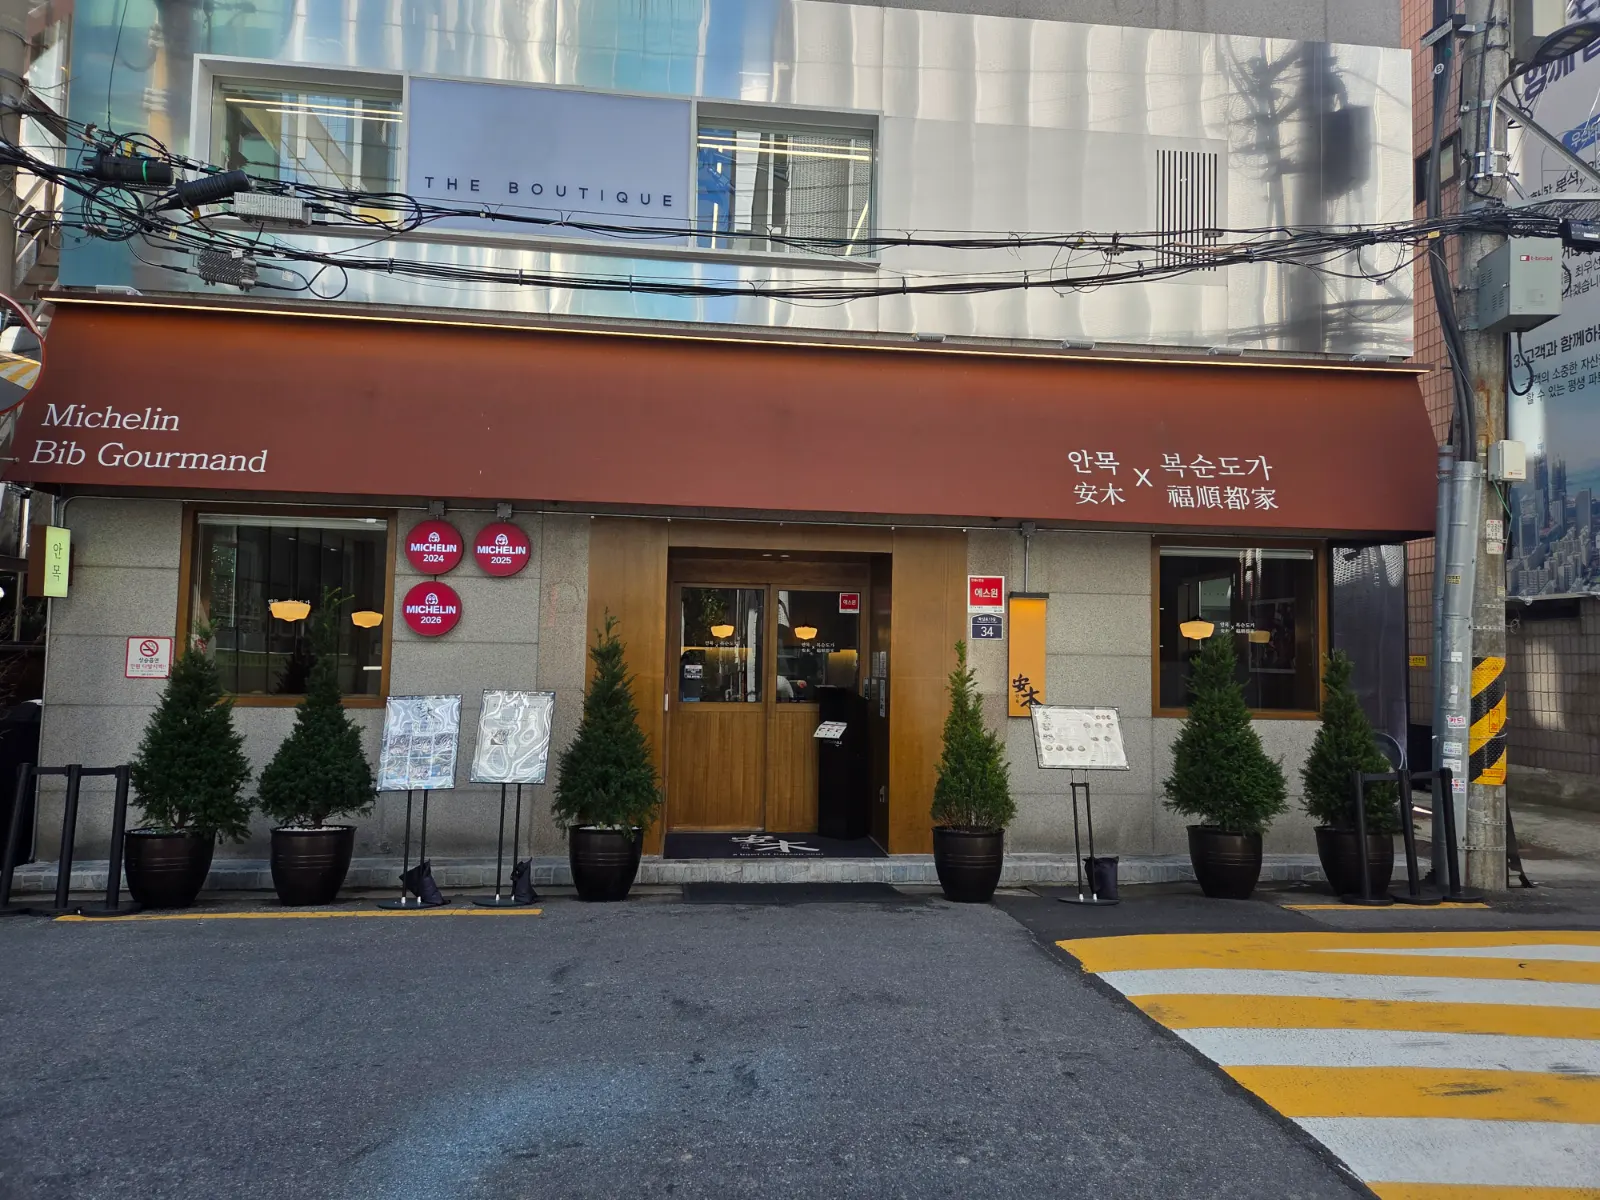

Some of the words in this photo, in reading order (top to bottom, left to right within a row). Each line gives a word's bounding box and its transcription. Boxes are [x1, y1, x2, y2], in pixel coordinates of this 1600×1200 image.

[424, 176, 480, 192] THE
[508, 181, 672, 206] BOUTIQUE
[1561, 324, 1600, 353] 함께하
[1552, 361, 1578, 380] 소중한
[1581, 354, 1600, 370] 자산
[1537, 389, 1545, 402] 수
[1548, 383, 1566, 398] 있는
[1568, 376, 1586, 392] 평생
[41, 403, 179, 431] Michelin
[29, 439, 85, 466] Bib
[97, 442, 268, 473] Gourmand
[1068, 449, 1120, 476] 안목
[1160, 453, 1273, 481] 복순도가
[1073, 482, 1126, 506] 安木
[1166, 485, 1279, 510] 福順都家
[410, 543, 457, 552] MICHELIN
[423, 554, 444, 562] 2024
[477, 546, 526, 554] MICHELIN
[491, 556, 512, 564] 2025
[52, 542, 63, 582] 안목
[974, 588, 998, 598] 에스원
[406, 605, 456, 614] MICHELIN
[420, 616, 442, 624] 2026
[980, 626, 994, 637] 34
[1012, 674, 1043, 708] 安木
